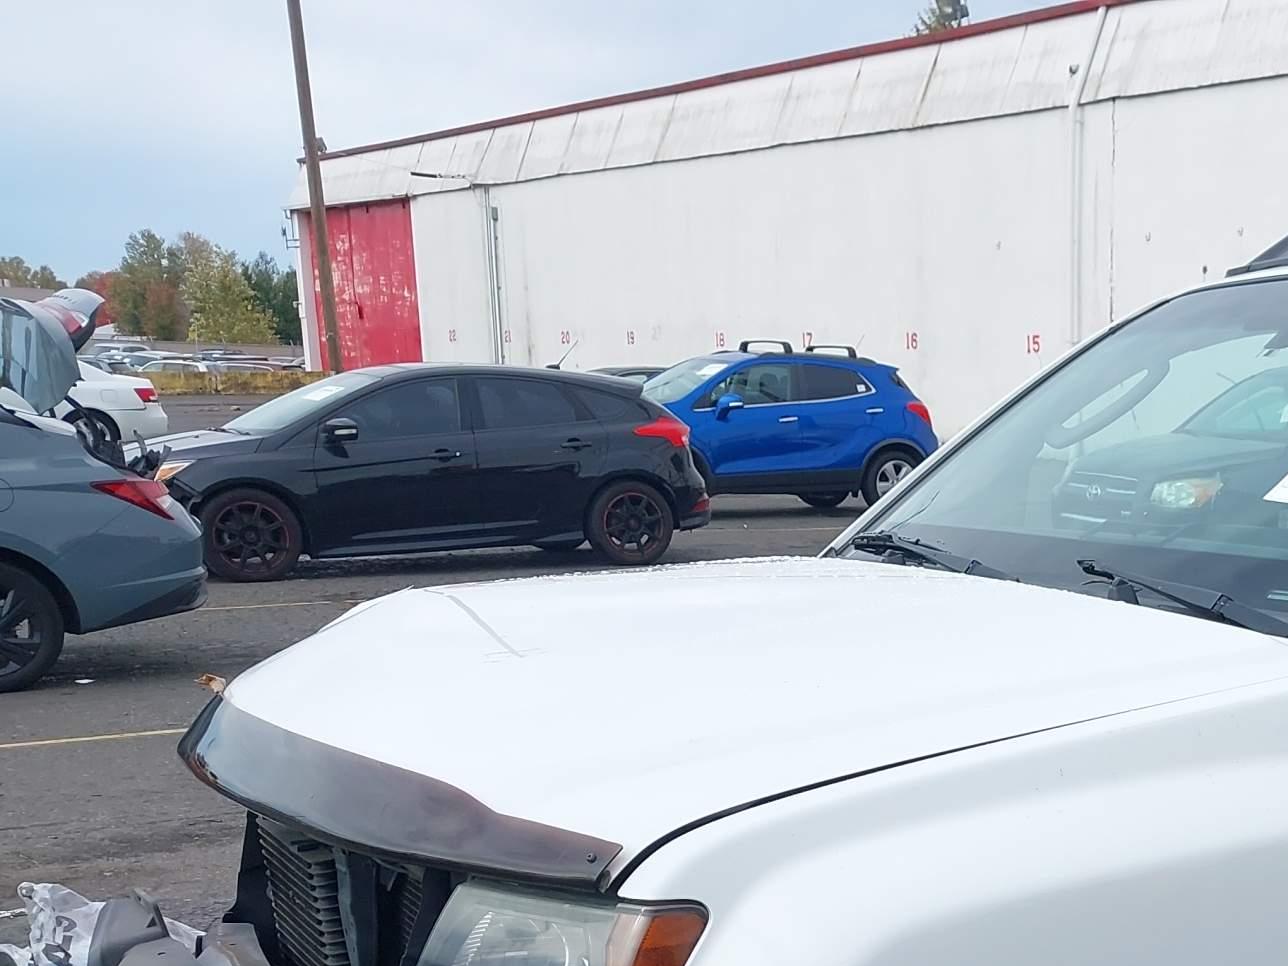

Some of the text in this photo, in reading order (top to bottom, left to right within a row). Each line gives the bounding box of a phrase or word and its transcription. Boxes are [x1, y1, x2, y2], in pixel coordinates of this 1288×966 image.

[448, 329, 457, 342] 22
[561, 331, 571, 345] 20
[627, 331, 635, 345] 19
[715, 332, 726, 348] 18
[802, 332, 813, 348] 17
[905, 332, 918, 349] 16
[1026, 335, 1041, 353] 15
